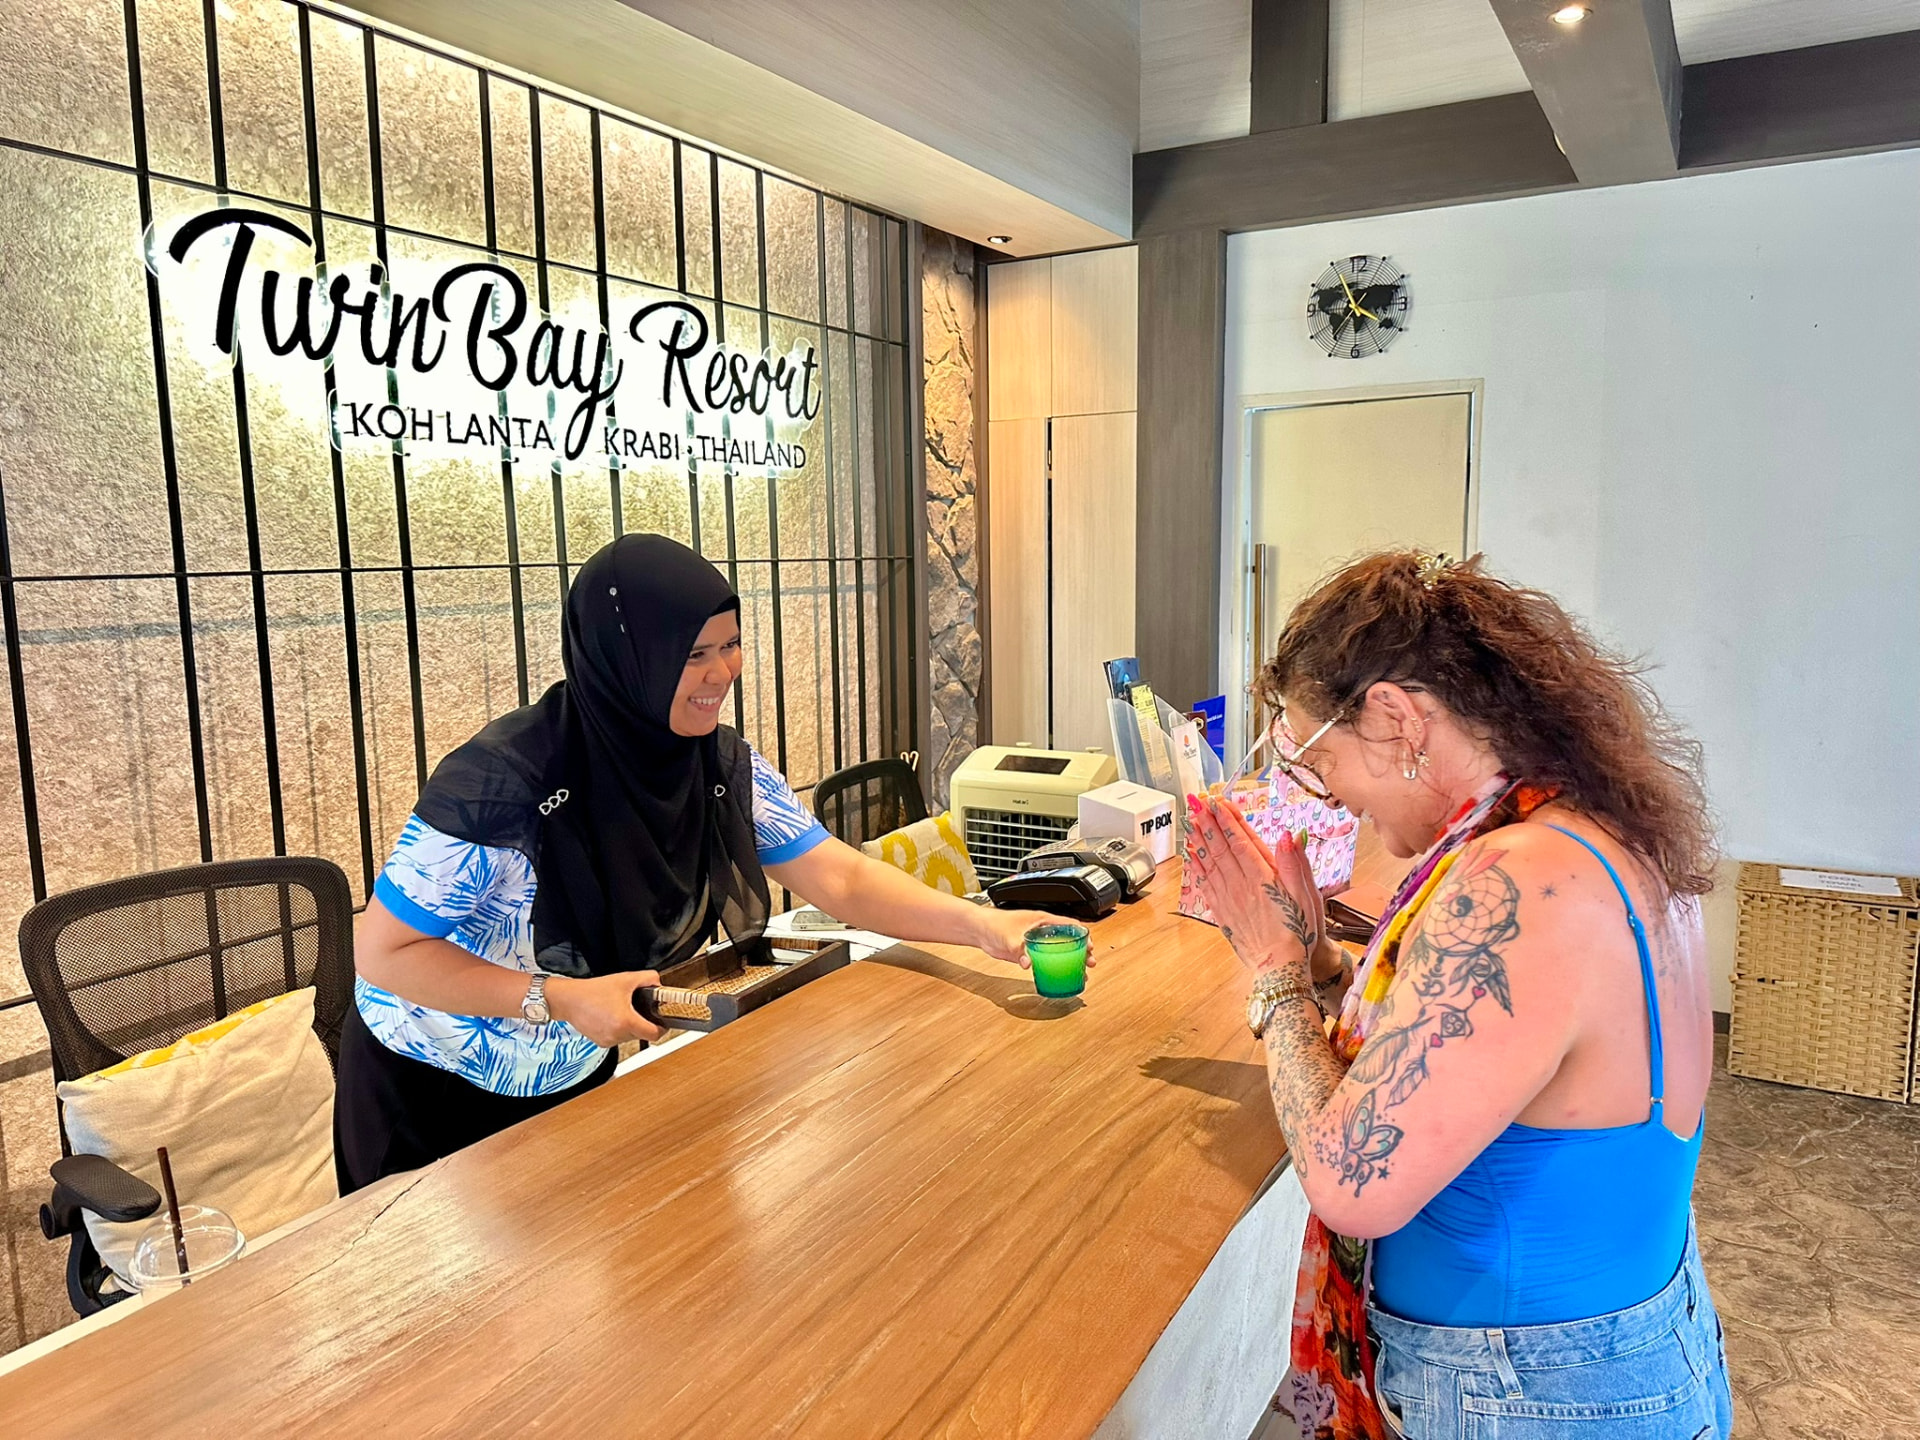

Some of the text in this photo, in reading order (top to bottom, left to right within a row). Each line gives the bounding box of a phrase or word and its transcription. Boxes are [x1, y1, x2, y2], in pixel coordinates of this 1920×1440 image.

[1349, 255, 1368, 273] 12
[1307, 303, 1316, 318] 9
[1397, 296, 1408, 311] 3
[1350, 344, 1360, 359] 6
[432, 262, 624, 461] Bay
[629, 301, 822, 421] Resort
[350, 402, 806, 469] KOH LANTA KRABI THAILAND
[1140, 811, 1172, 836] TIP BOX
